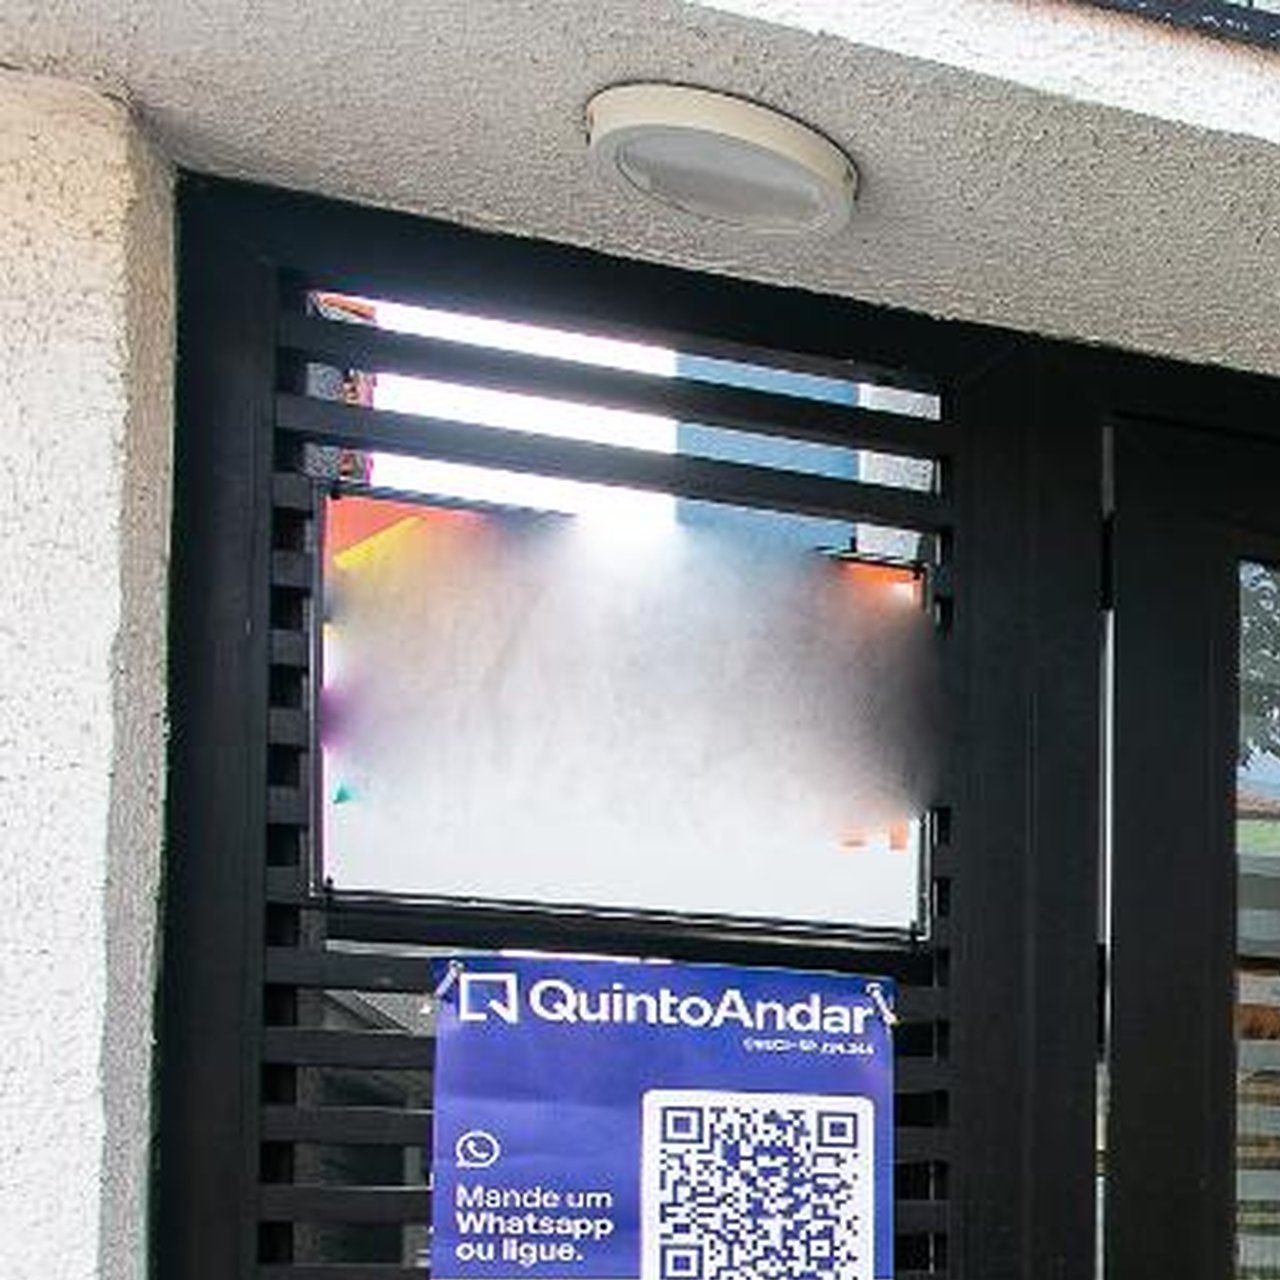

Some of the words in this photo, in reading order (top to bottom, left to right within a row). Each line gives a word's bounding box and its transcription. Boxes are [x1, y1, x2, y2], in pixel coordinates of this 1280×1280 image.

[530, 979, 873, 1034] QuintoAndar
[456, 1185, 559, 1209] Mande
[566, 1189, 613, 1209] um
[456, 1211, 614, 1243] Whatsapp
[456, 1242, 496, 1262] ou
[502, 1238, 583, 1268] ligue.
